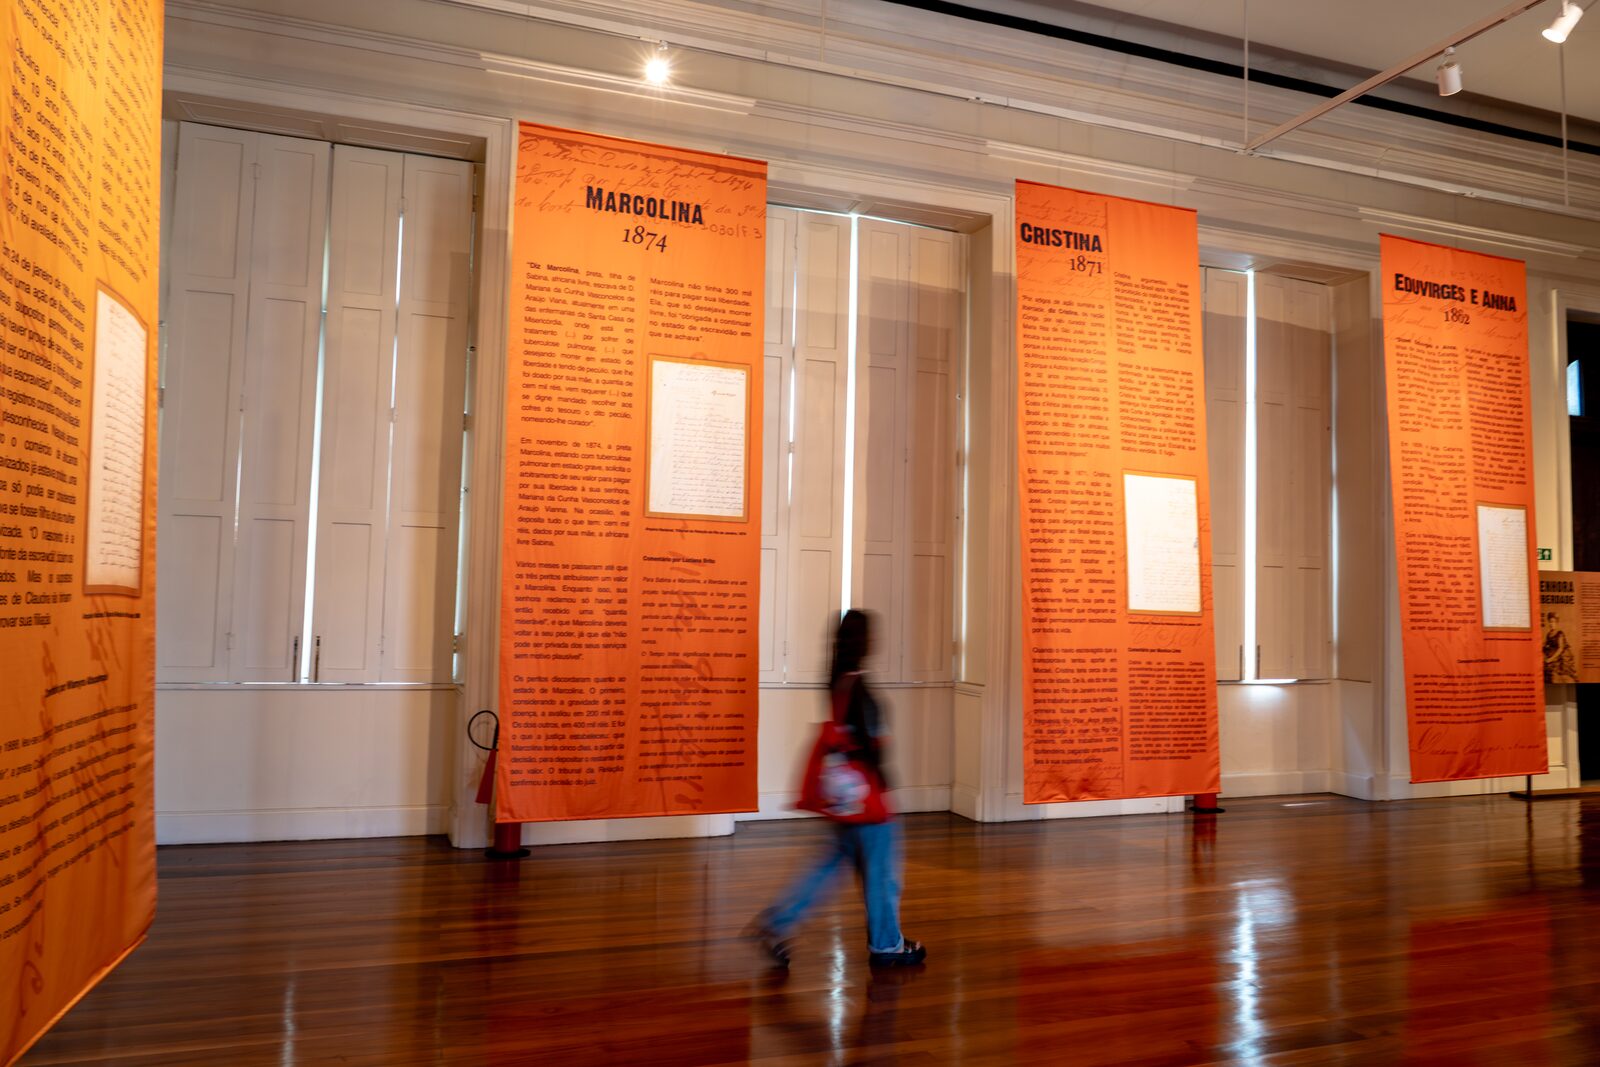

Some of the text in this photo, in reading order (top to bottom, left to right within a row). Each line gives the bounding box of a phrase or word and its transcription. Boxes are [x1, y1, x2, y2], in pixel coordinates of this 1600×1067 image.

[586, 186, 704, 225] MARCOLINA
[622, 225, 667, 253] 1874
[1020, 222, 1103, 252] CRISTINA
[1069, 255, 1103, 277] 1871
[1395, 273, 1517, 313] EDUVIRGES E ANNA
